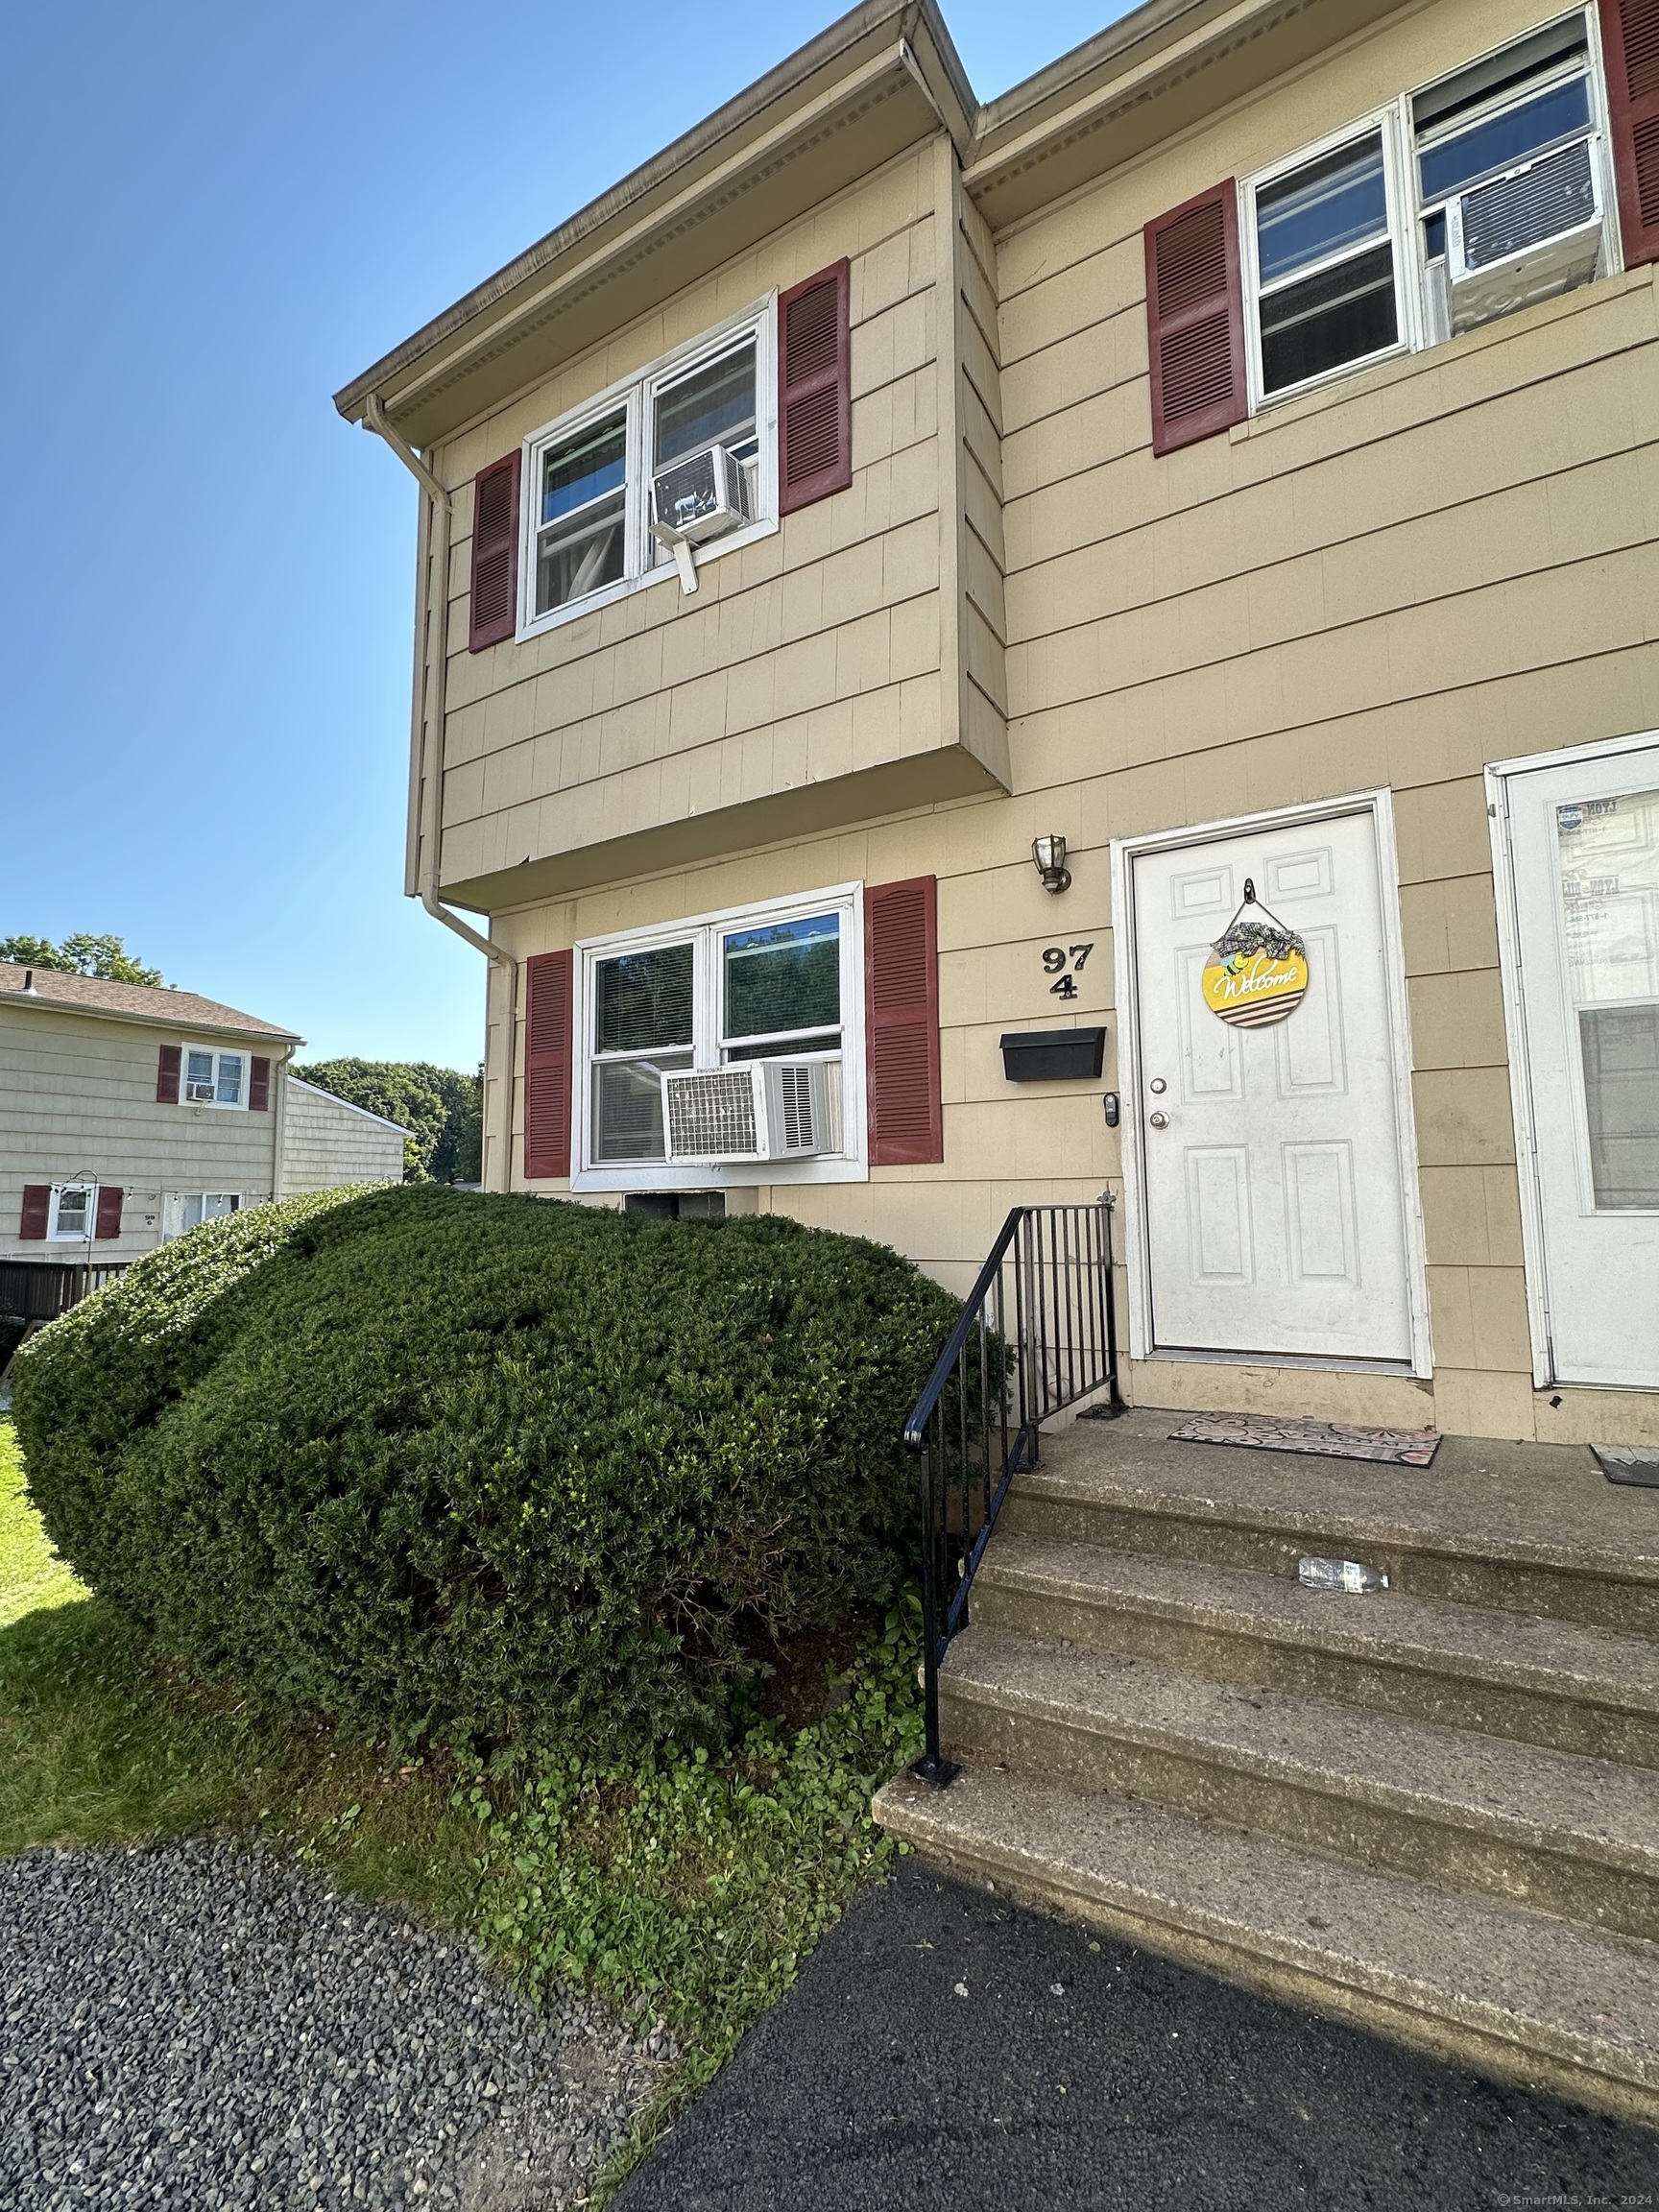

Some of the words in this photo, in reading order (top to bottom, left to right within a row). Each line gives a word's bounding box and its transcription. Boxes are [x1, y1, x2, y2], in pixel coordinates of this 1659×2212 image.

[1043, 943, 1094, 974] 97
[1049, 974, 1078, 1000] 4
[1214, 953, 1298, 999] Welcome
